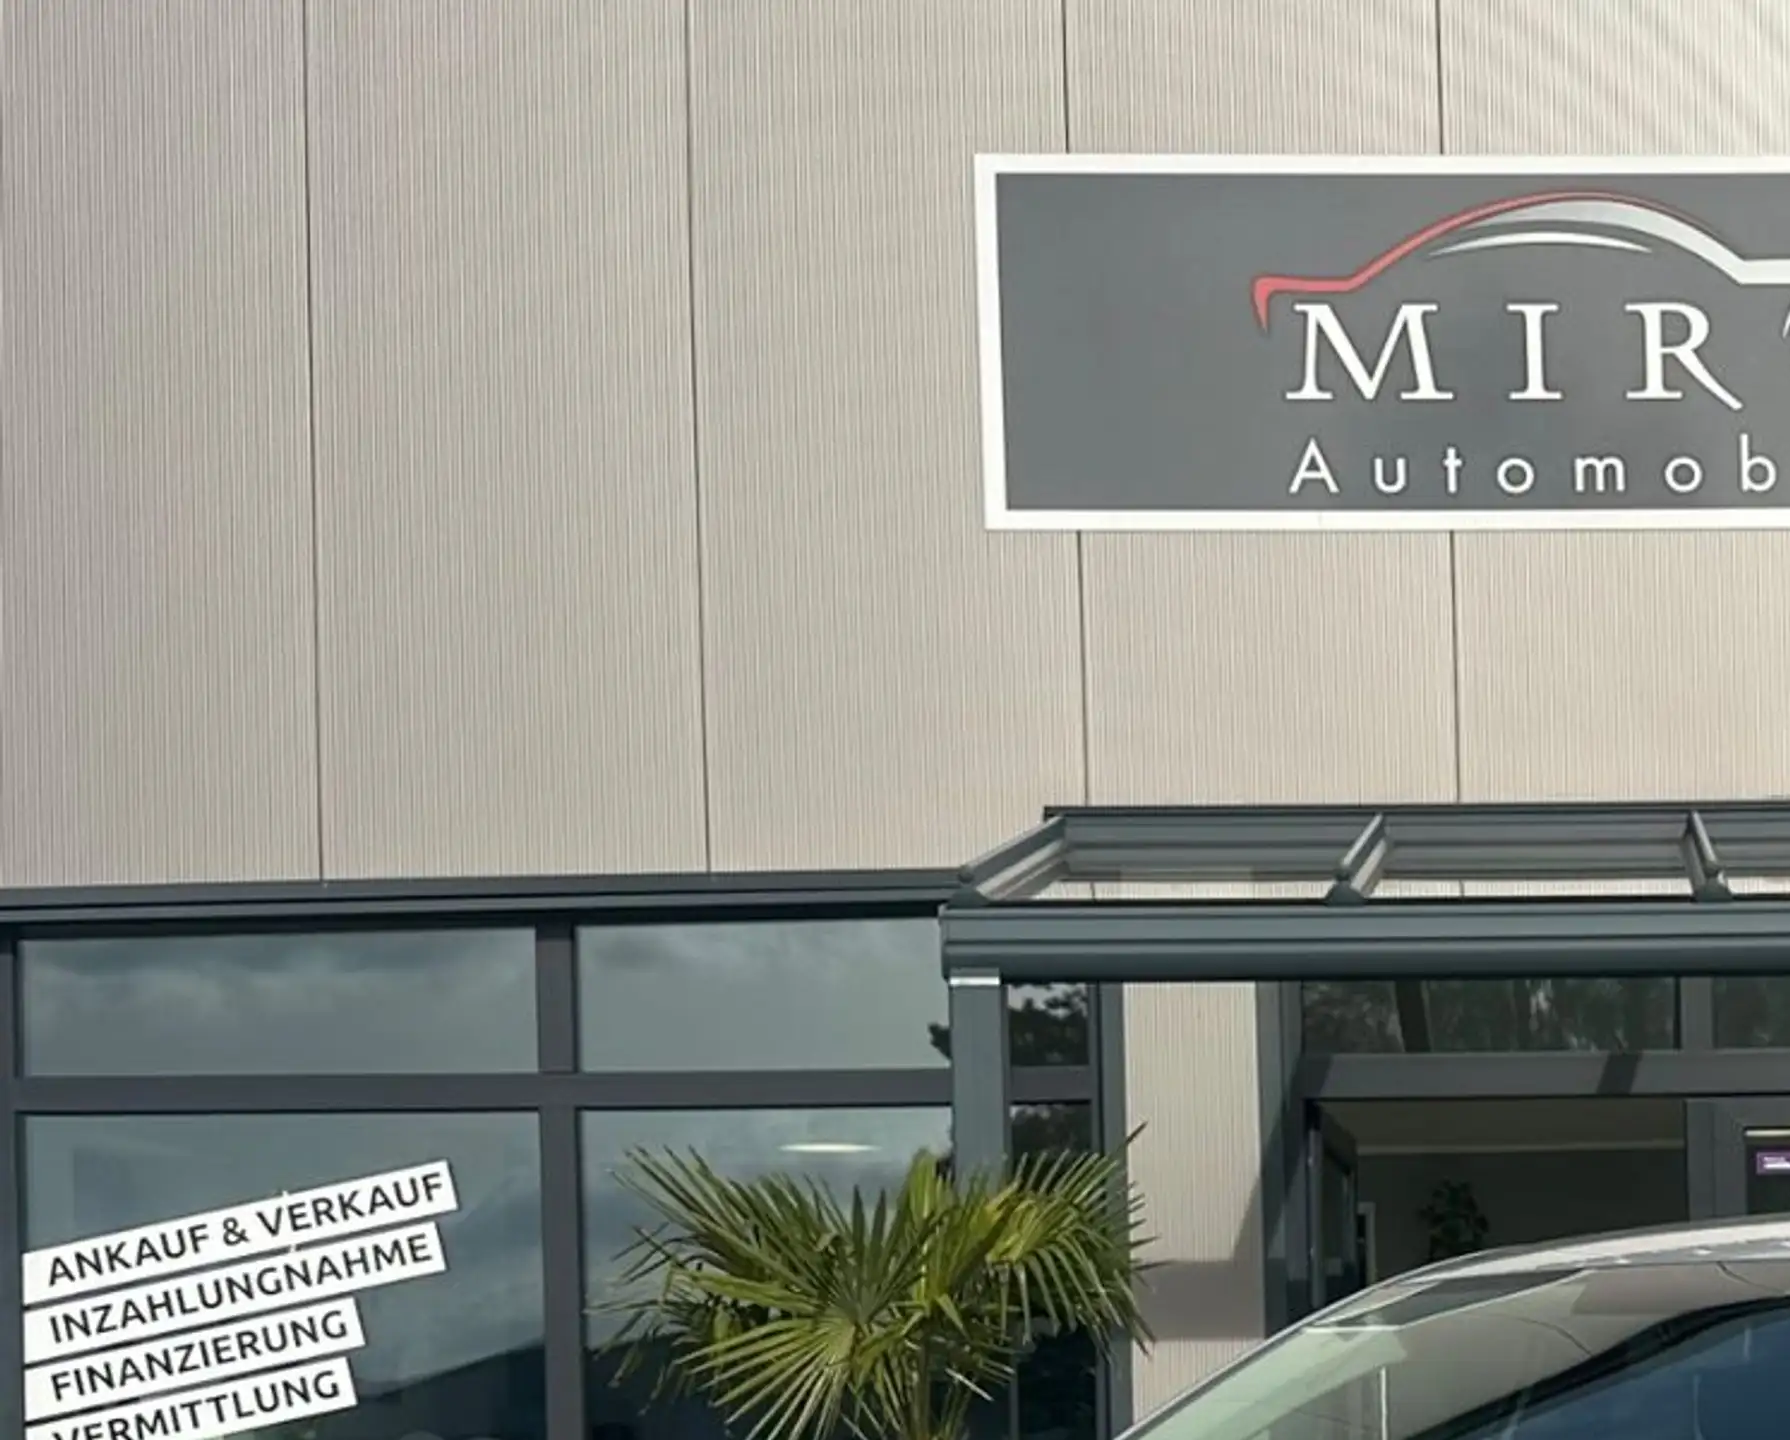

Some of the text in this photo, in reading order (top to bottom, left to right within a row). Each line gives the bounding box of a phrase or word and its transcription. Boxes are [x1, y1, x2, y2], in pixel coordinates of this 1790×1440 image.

[48, 1171, 444, 1287] ANKAUF & VERKAUF
[49, 1232, 434, 1343] INZAHLUNGNAHME
[50, 1309, 350, 1402] FINANZIERUNG
